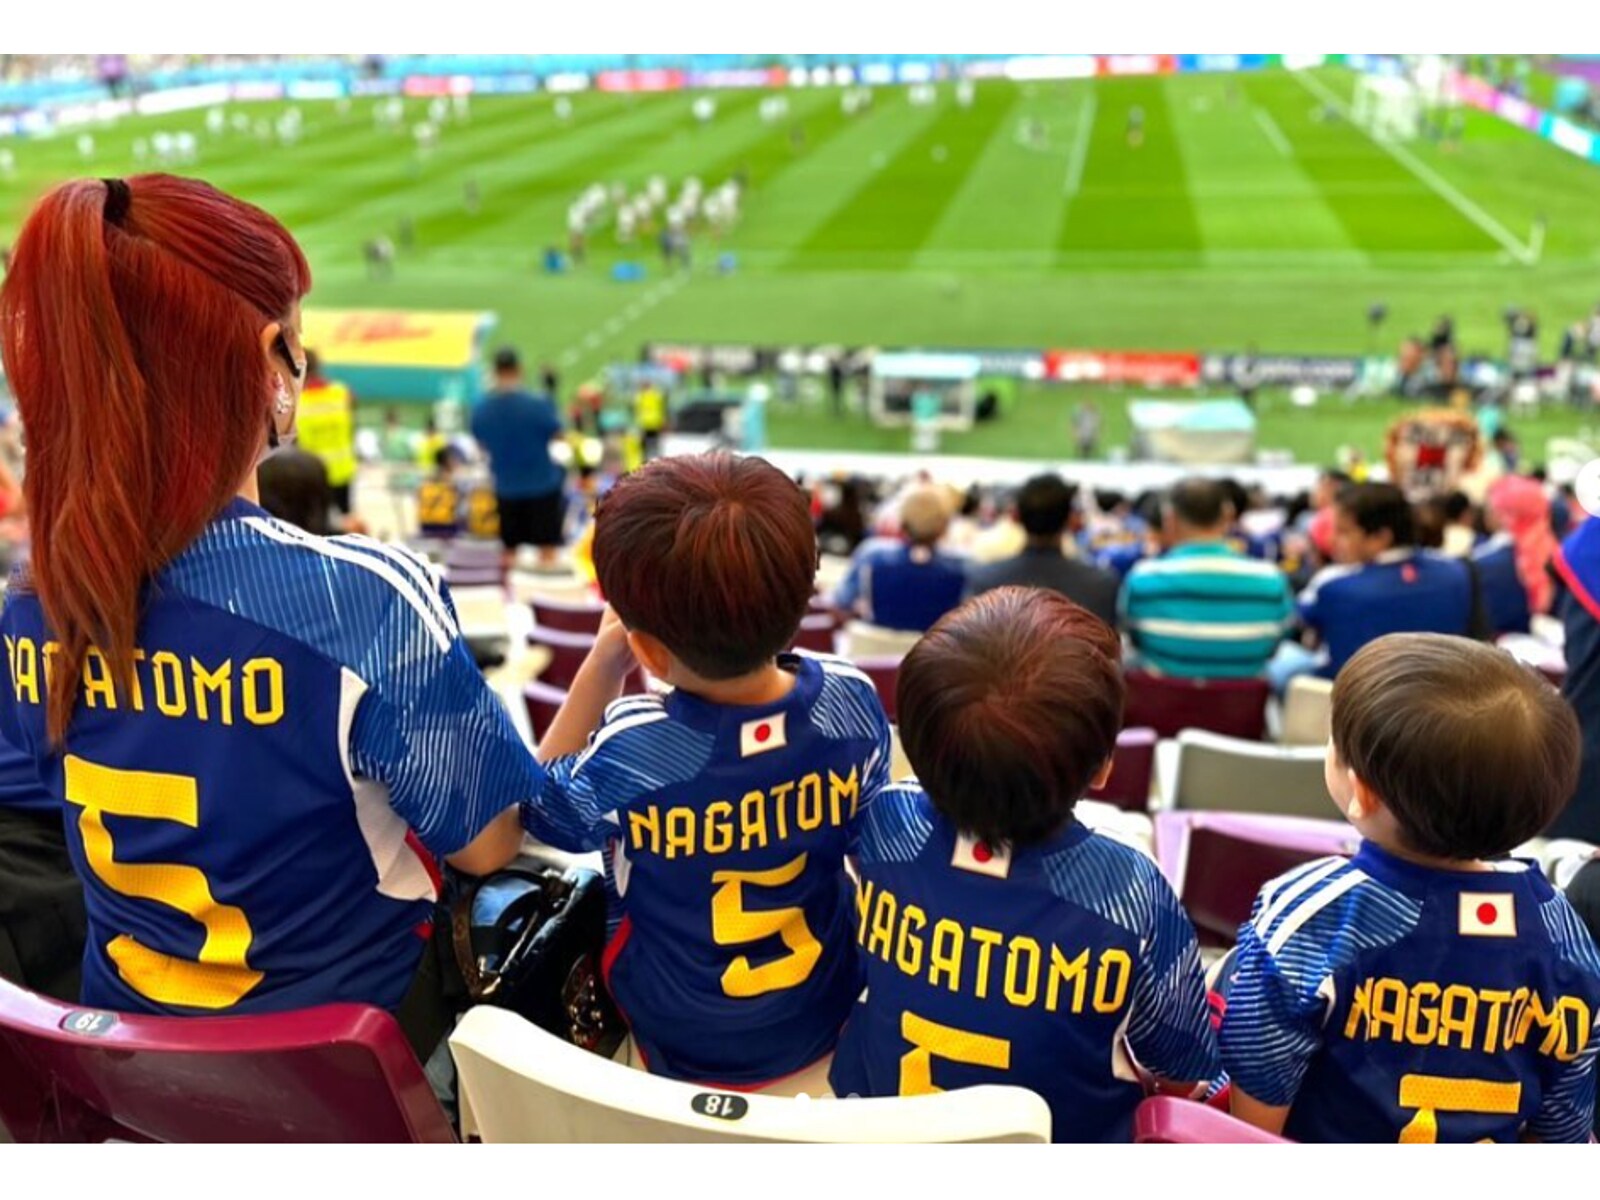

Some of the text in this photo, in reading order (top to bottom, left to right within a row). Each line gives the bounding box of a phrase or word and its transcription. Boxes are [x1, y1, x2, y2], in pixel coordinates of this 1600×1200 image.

[63, 754, 265, 1010] 5
[711, 850, 823, 997] 5
[75, 1012, 103, 1032] 19
[1344, 976, 1590, 1062] NAGATOMO
[704, 1095, 734, 1117] 18
